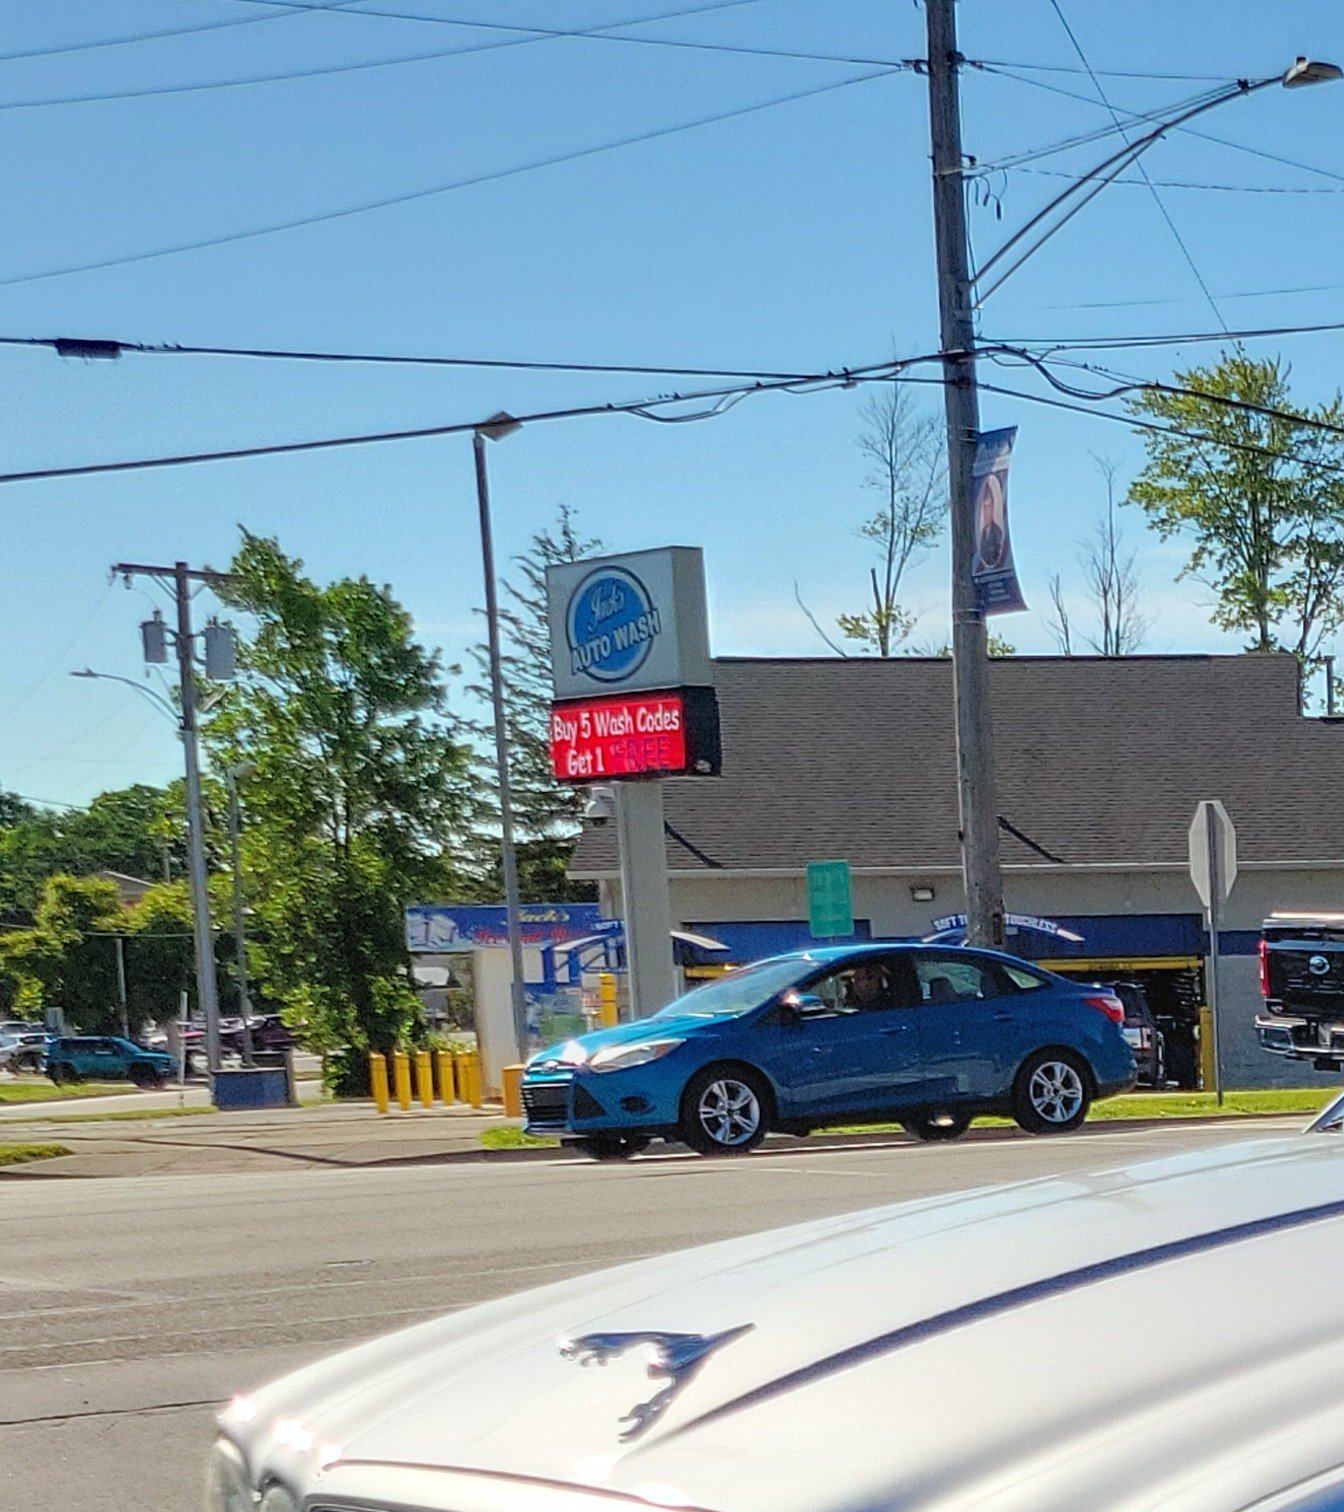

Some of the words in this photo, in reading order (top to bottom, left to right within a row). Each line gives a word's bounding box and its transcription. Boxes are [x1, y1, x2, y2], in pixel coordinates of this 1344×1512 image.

[571, 634, 612, 676] AUTO
[613, 606, 661, 653] WASH
[553, 715, 578, 748] Buy
[581, 711, 592, 739] 5
[593, 706, 635, 737] Wash
[637, 703, 680, 733] Codes
[567, 748, 593, 776] Get
[595, 746, 605, 772] 1
